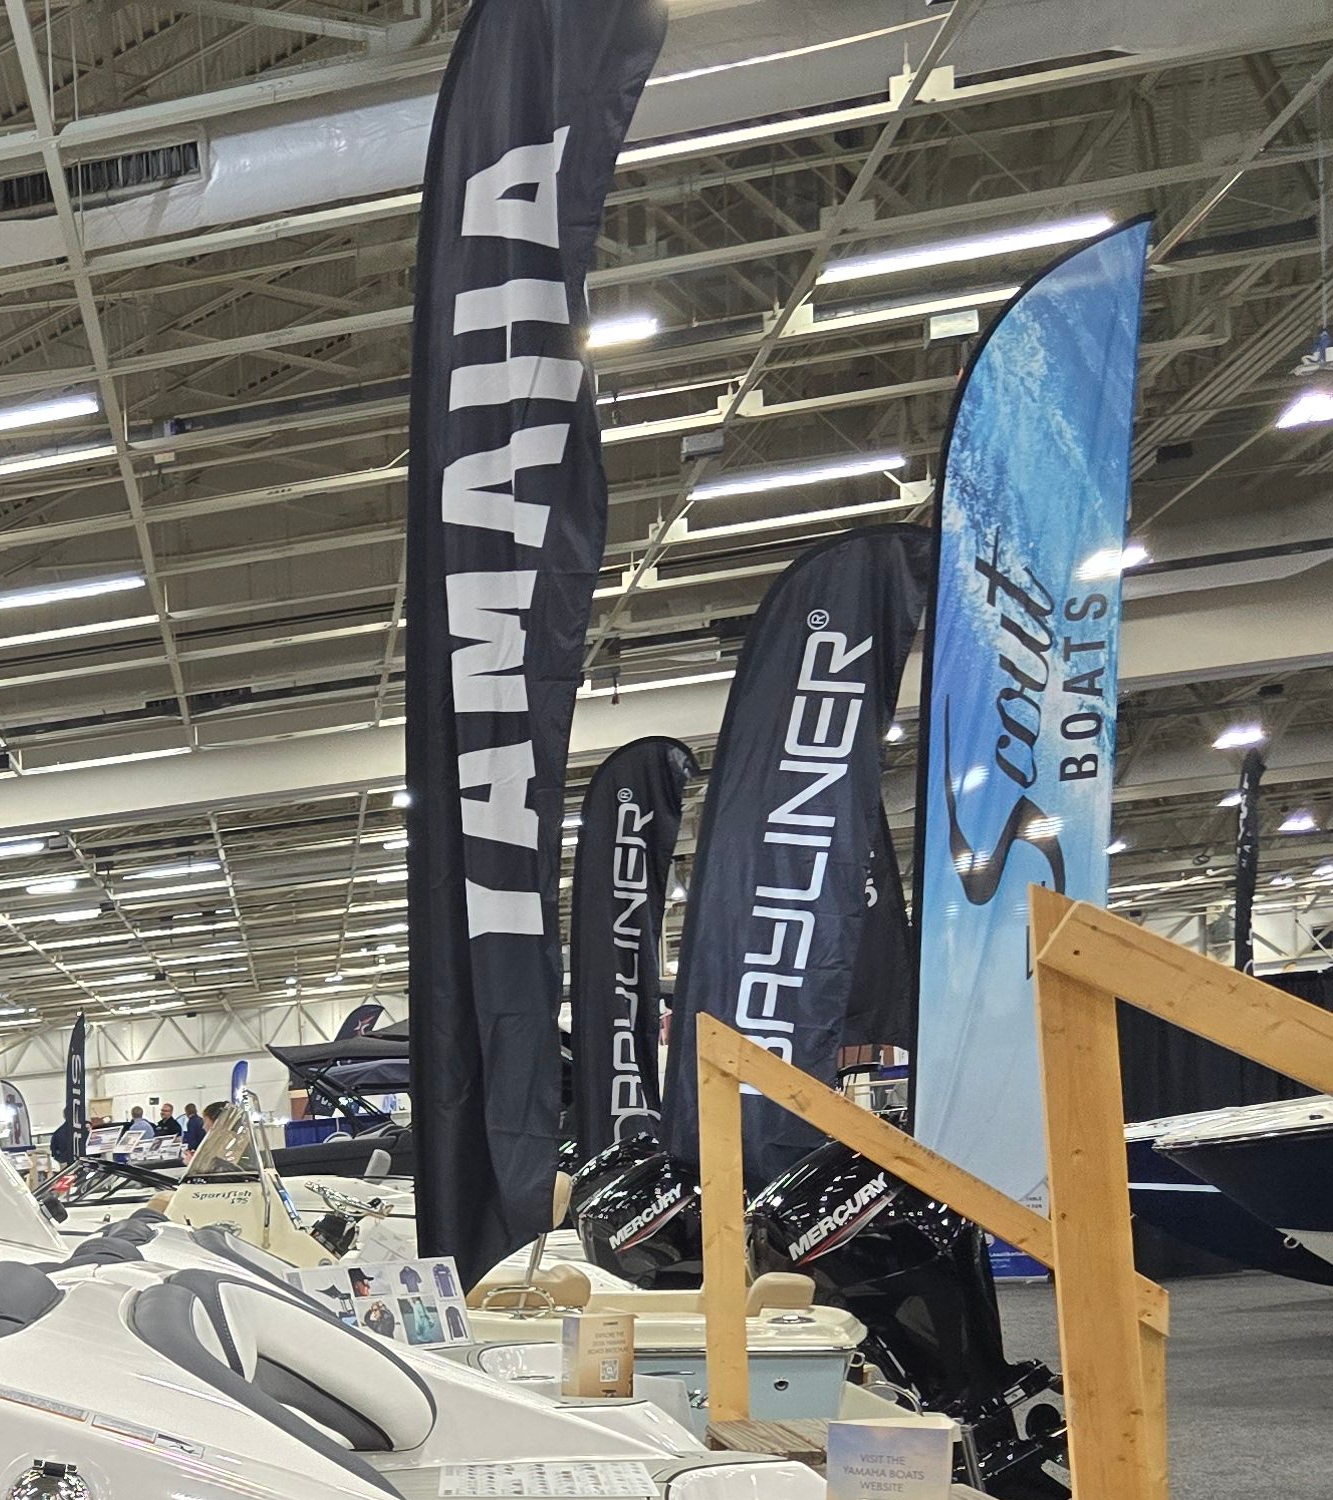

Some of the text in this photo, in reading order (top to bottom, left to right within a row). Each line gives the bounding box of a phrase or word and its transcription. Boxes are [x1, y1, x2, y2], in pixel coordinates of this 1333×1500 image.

[945, 525, 1066, 906] Scout
[1059, 593, 1109, 782] BOATS
[609, 1182, 683, 1250] MERCURY
[788, 1172, 888, 1261] MERCURY
[843, 1465, 925, 1480] YAMAHA BOATS
[860, 1454, 906, 1465] VISIT THE
[860, 1481, 904, 1492] WEBSITE
